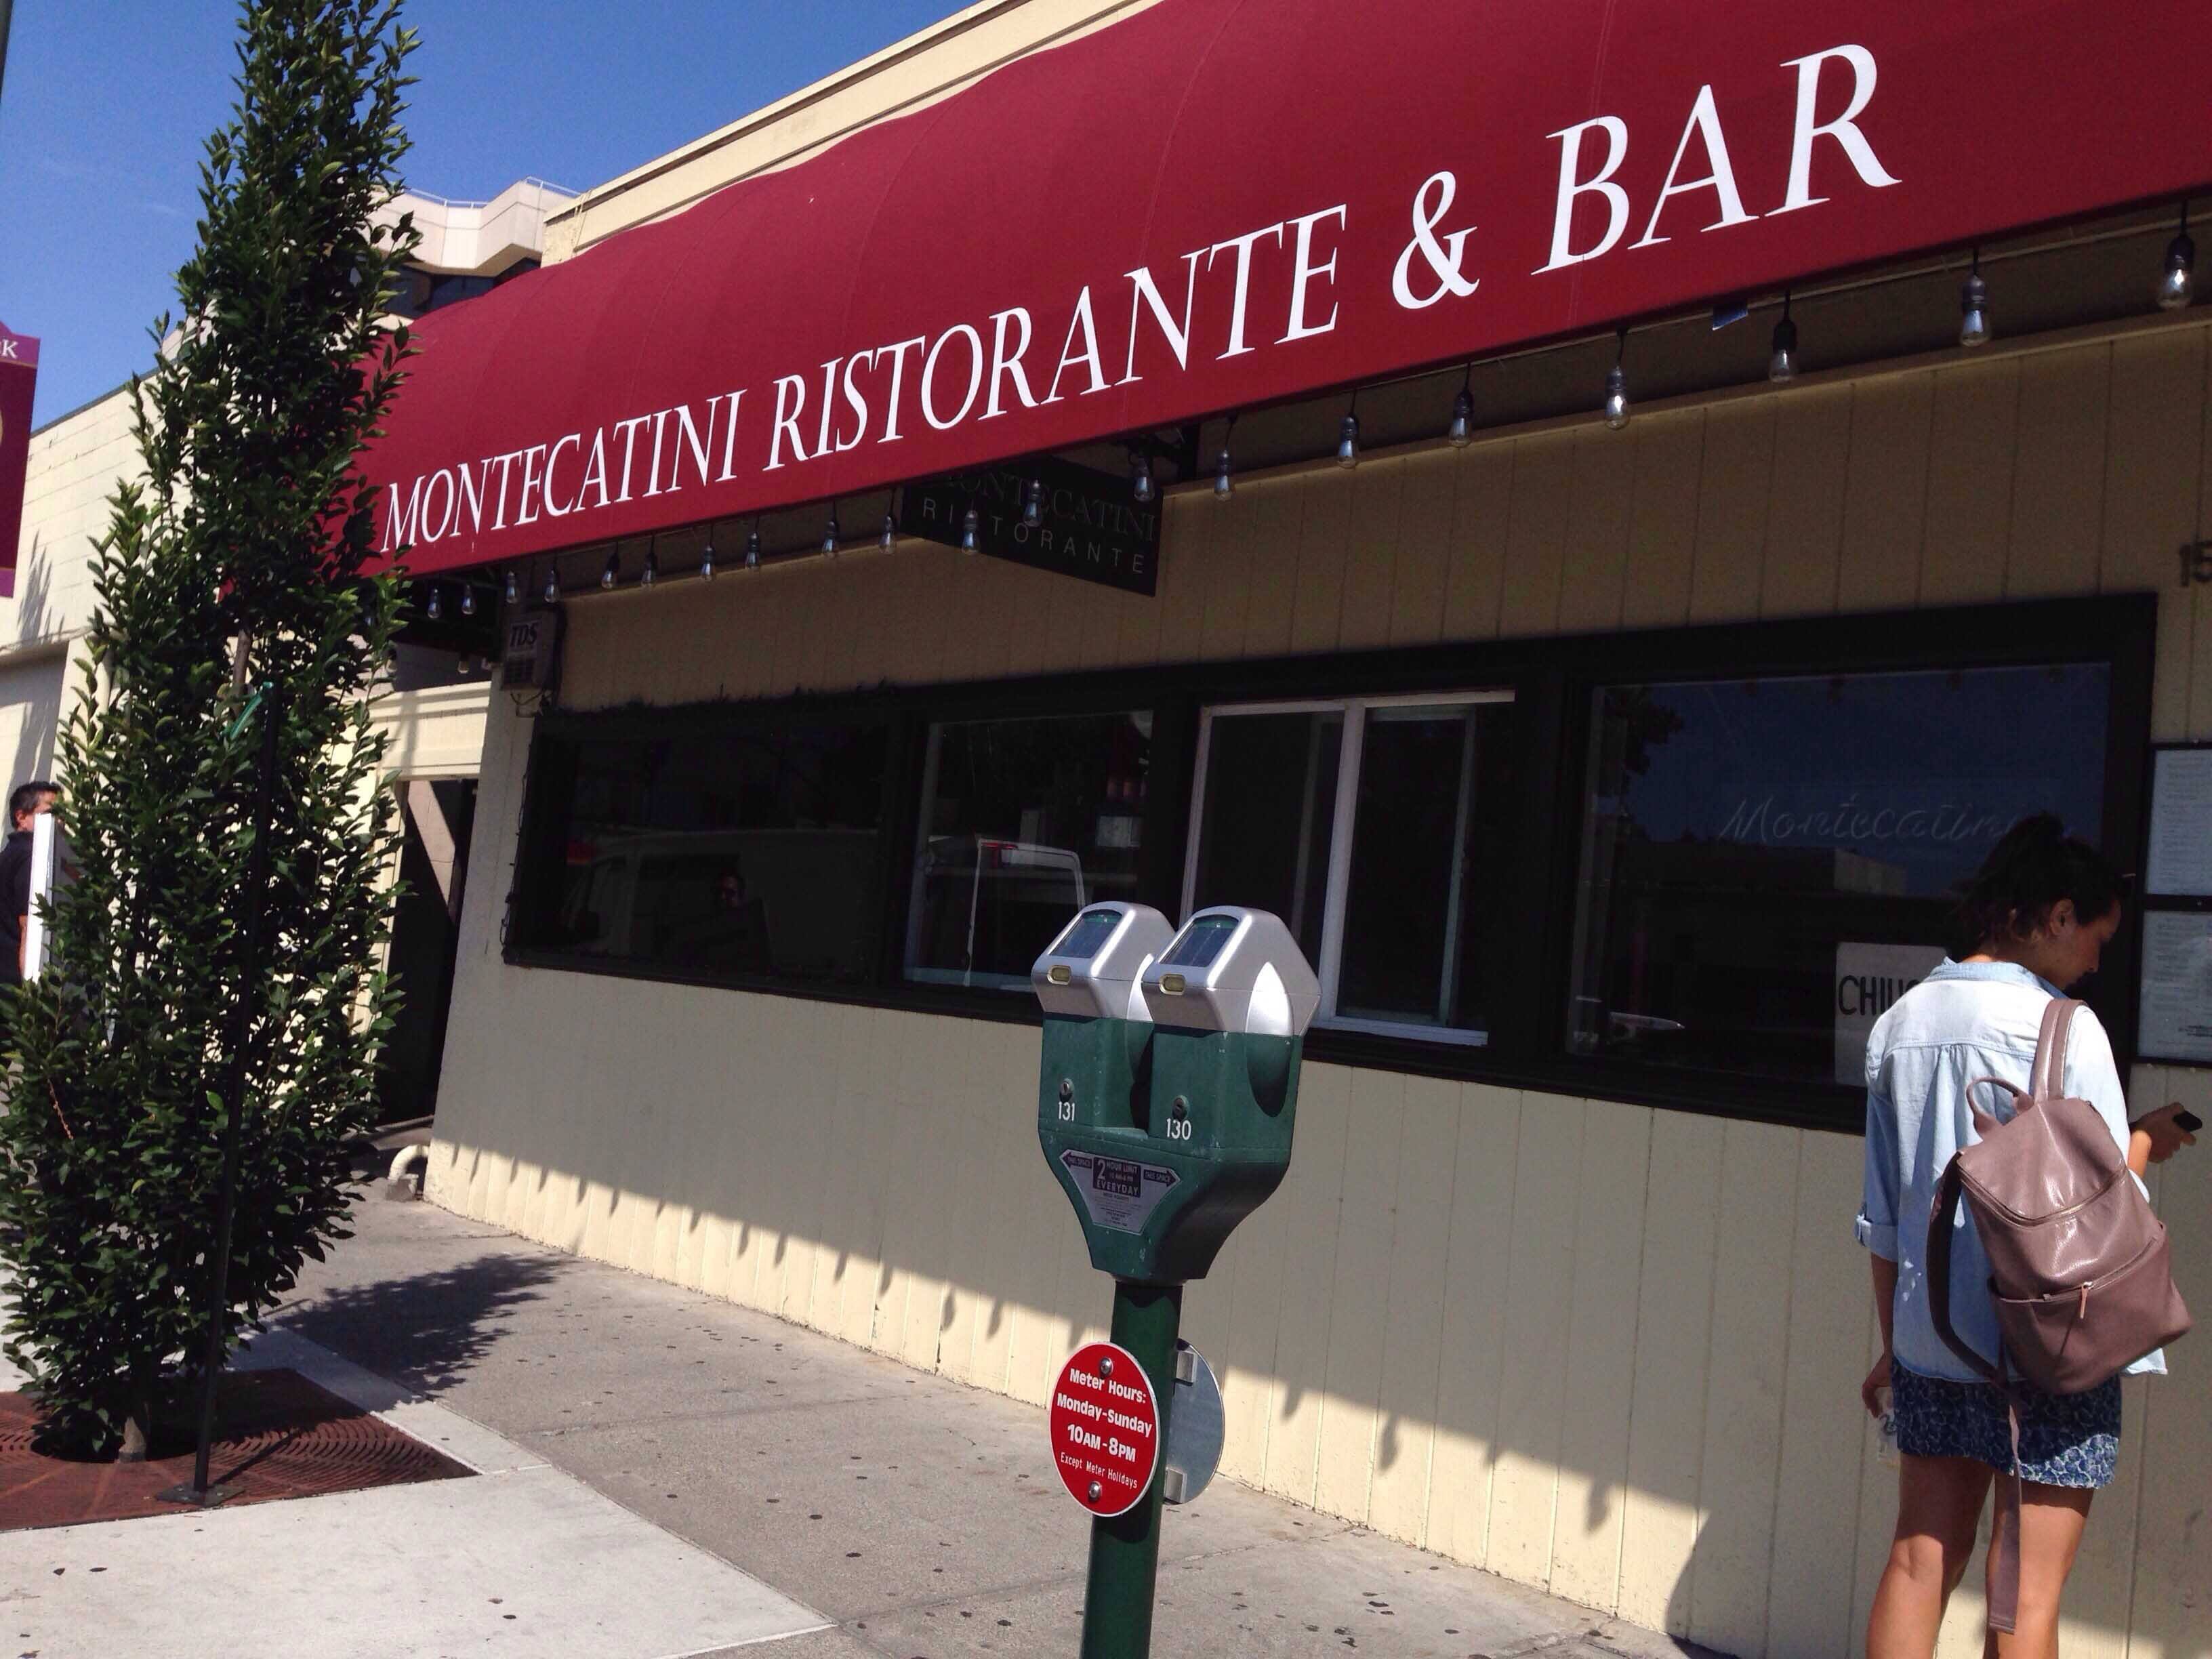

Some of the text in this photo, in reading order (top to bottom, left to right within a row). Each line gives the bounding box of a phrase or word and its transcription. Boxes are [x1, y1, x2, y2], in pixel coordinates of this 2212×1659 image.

[380, 43, 1902, 553] MONTECATINI RISTORANTE & BAR
[0, 338, 18, 359] K
[922, 497, 1145, 574] RITORANTE
[1057, 1101, 1076, 1122] 131
[1166, 1118, 1191, 1141] 130
[1098, 1160, 1106, 1179] 2
[1097, 1179, 1139, 1195] EVERYDAY
[1069, 1368, 1147, 1404] Meter Hours:
[1057, 1393, 1153, 1438] Monday-Sunday
[1061, 1452, 1138, 1490] Except Meter Holidays
